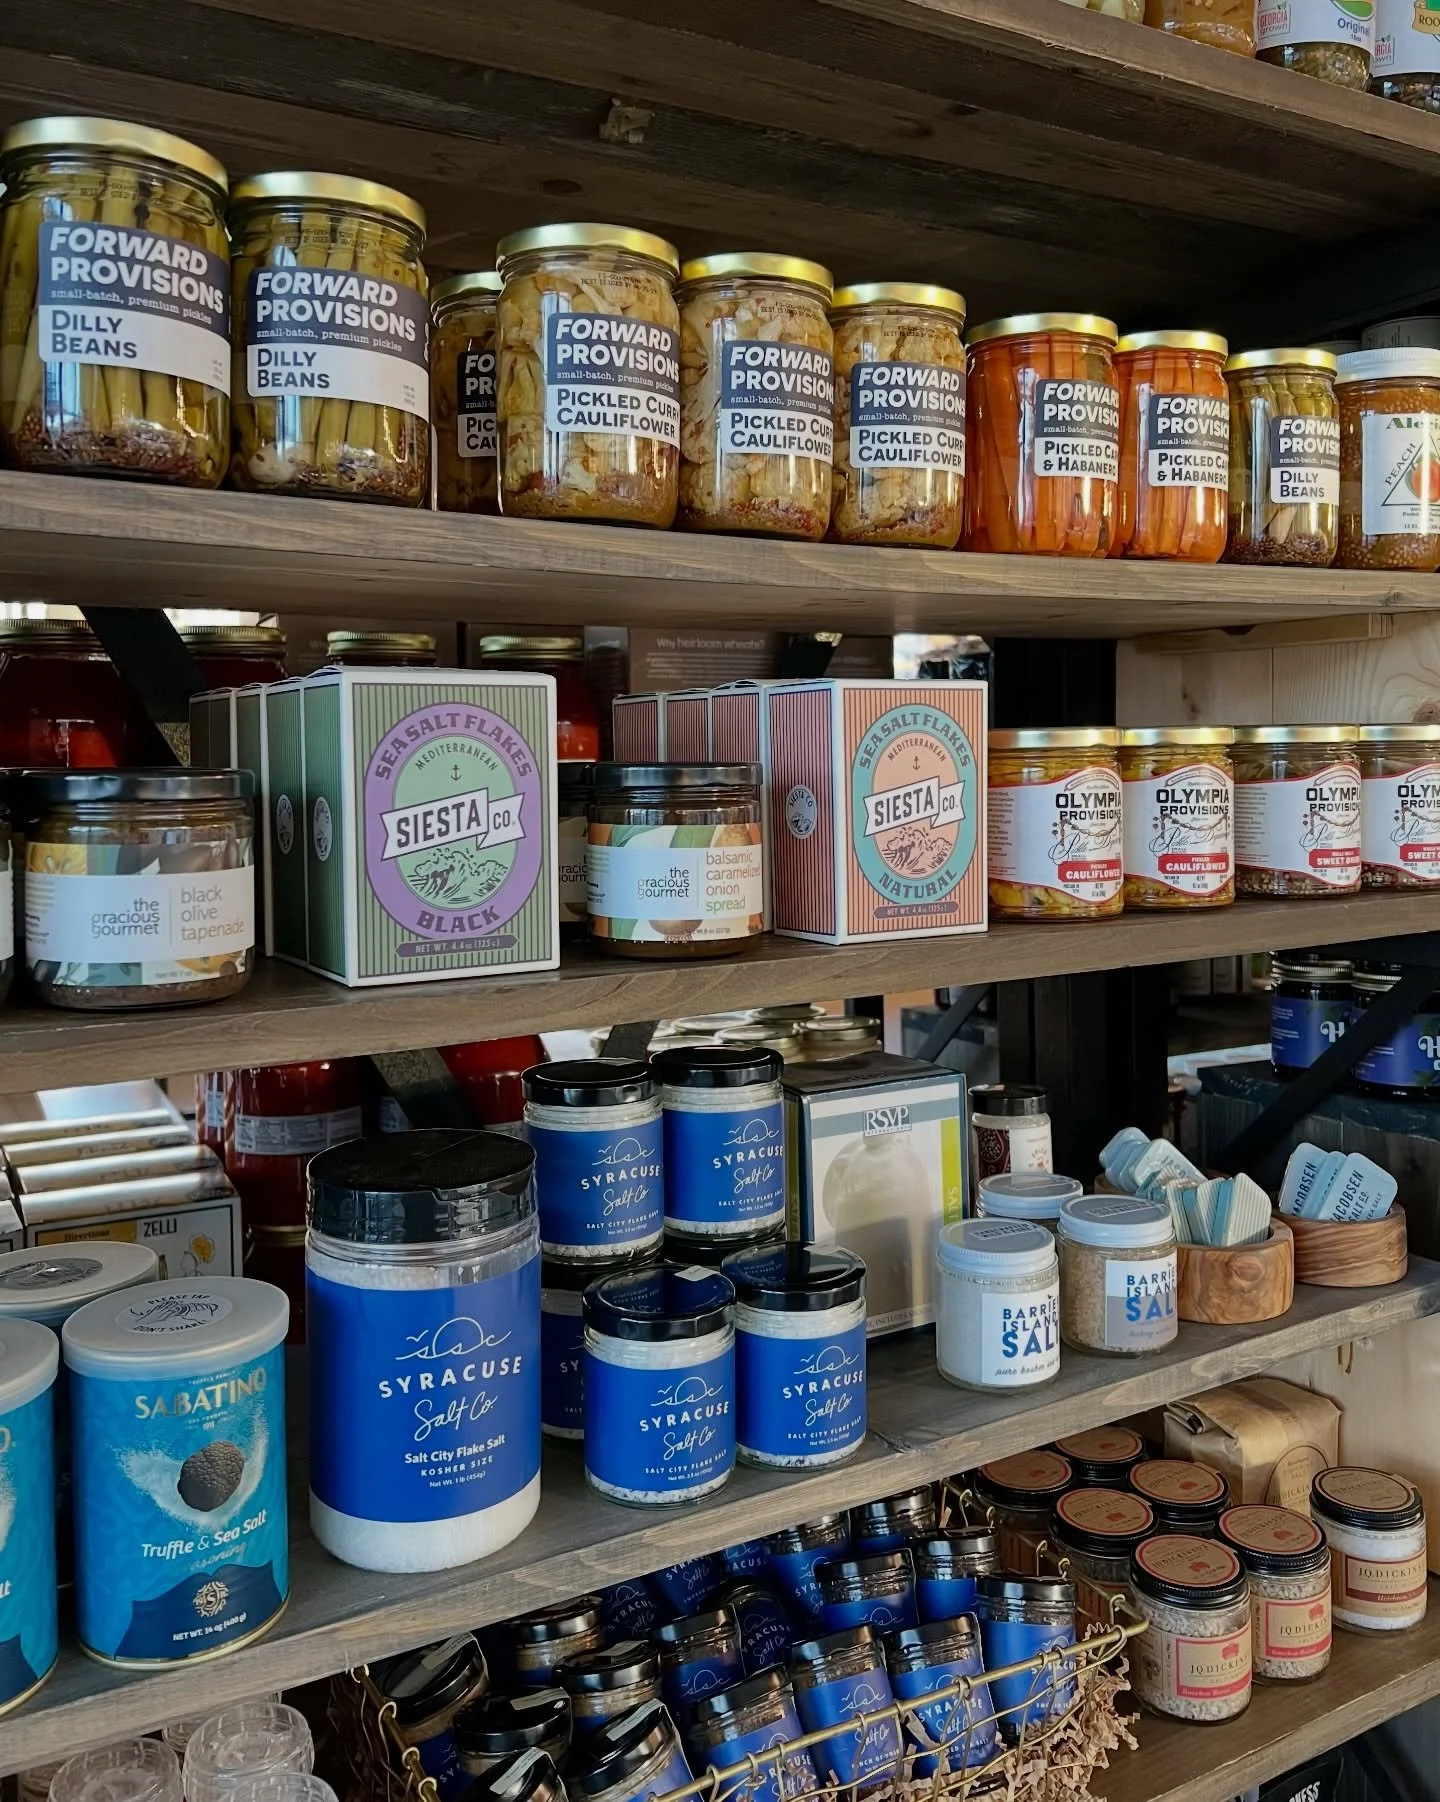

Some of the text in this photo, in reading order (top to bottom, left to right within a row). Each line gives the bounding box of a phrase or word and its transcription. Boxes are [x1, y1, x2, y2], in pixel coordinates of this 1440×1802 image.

[1259, 23, 1288, 35] grown
[1260, 12, 1288, 27] GEORGIA
[1337, 17, 1371, 35] Original
[50, 226, 208, 276] FORWARD
[51, 257, 224, 314] PROVISIONS
[256, 272, 398, 307] FORWARD
[51, 289, 213, 324] small-batch, premium pickles
[51, 310, 124, 334] DILLY
[256, 300, 416, 342] PROVISIONS
[256, 328, 403, 352] small-batch, premium pickles
[555, 318, 672, 352] FORWARD
[51, 332, 138, 359] BEANS
[257, 348, 317, 367] DILLY
[556, 343, 680, 384] PROVISIONS
[730, 346, 831, 378] FORWARD
[257, 369, 330, 389] BEANS
[556, 370, 655, 387] small-batch, premium
[858, 366, 960, 393] FORWARD
[557, 388, 641, 411] PICKLED
[730, 395, 818, 411] small-batch, premium
[859, 389, 966, 419] PROVISIONS
[557, 406, 676, 439] CAULIFLOWER
[731, 412, 807, 433] PICKLED
[858, 412, 945, 426] small-batch, premium
[730, 430, 832, 456] CAULIFLOWER
[859, 429, 933, 447] PICKLED
[858, 446, 962, 468] CAULIFLOWER
[1044, 440, 1102, 457] PICKLED
[1043, 459, 1054, 472] &
[1158, 453, 1214, 467] PICKLED
[1385, 442, 1416, 486] PEACH
[1157, 470, 1168, 482] &
[1280, 470, 1319, 484] DILLY
[1280, 485, 1325, 498] BEANS
[657, 638, 766, 650] Why heirloom wheats?
[375, 712, 532, 780] SEA SALT FLAKES
[860, 712, 971, 769] SEA SALT FLAKES
[888, 738, 946, 762] MEDITERRANEAN
[414, 742, 499, 771] MEDITERRANEAN
[874, 785, 934, 827] SIESTA
[1055, 792, 1121, 809] OLYMPIA
[1156, 788, 1230, 805] OLYMPIA
[1059, 809, 1122, 821] PROVISIONS
[1159, 805, 1229, 816] PROVISIONS
[396, 799, 482, 848] SIESTA
[706, 851, 753, 866] balsamic
[1316, 858, 1345, 866] SWEET
[1407, 852, 1437, 860] SWEET
[669, 866, 690, 879] the
[1066, 869, 1121, 880] CAULIFLOWER
[1165, 862, 1227, 872] CAULIFLOWER
[638, 876, 690, 889] gracious
[706, 882, 740, 896] onion
[879, 870, 958, 899] NATURAL
[181, 886, 223, 904] black
[638, 887, 690, 899] gourmet
[133, 898, 159, 912] the
[181, 906, 218, 922] olive
[706, 895, 746, 915] spread
[92, 910, 160, 926] gracious
[416, 905, 501, 933] BLACK
[92, 923, 160, 938] gourmet
[181, 919, 245, 945] tapenade
[415, 945, 432, 953] NET
[866, 1106, 909, 1131] RSVP
[712, 1145, 784, 1169] SYRACUSE
[580, 1164, 660, 1190] SYRACUSE
[733, 1167, 763, 1194] Salt
[603, 1188, 636, 1216] Salt
[755, 1193, 773, 1204] FLAKE
[143, 1218, 178, 1238] ZELLI
[608, 1220, 626, 1228] CITY
[628, 1213, 647, 1226] FLAKE
[1127, 1266, 1176, 1286] BARRIE
[1127, 1278, 1177, 1298] ISLAND
[147, 1294, 187, 1305] PLEASE
[1003, 1297, 1057, 1320] BARRIE
[1125, 1293, 1177, 1323] SAL
[1002, 1313, 1058, 1332] ISLAND
[378, 1356, 522, 1399] SYRACUSE
[995, 1363, 1046, 1377] pure kosher
[135, 1367, 268, 1419] SABATINO
[782, 1369, 864, 1399] SYRACUSE
[414, 1397, 469, 1442] Salt
[639, 1401, 730, 1432] SYRACUSE
[805, 1398, 838, 1427] Salt
[810, 1431, 828, 1439] CITY
[830, 1424, 850, 1436] FLAKE
[404, 1434, 506, 1464] Salt City Flake Salt
[663, 1431, 699, 1461] Salt
[420, 1455, 494, 1477] KOSHER SIZE
[645, 1449, 727, 1475] SALT CITY FLAKE SALT
[429, 1480, 442, 1488] Net
[466, 1470, 487, 1482] (454g)
[142, 1508, 268, 1561] Truffle & Sea Salt
[172, 1628, 203, 1641] NET WT.
